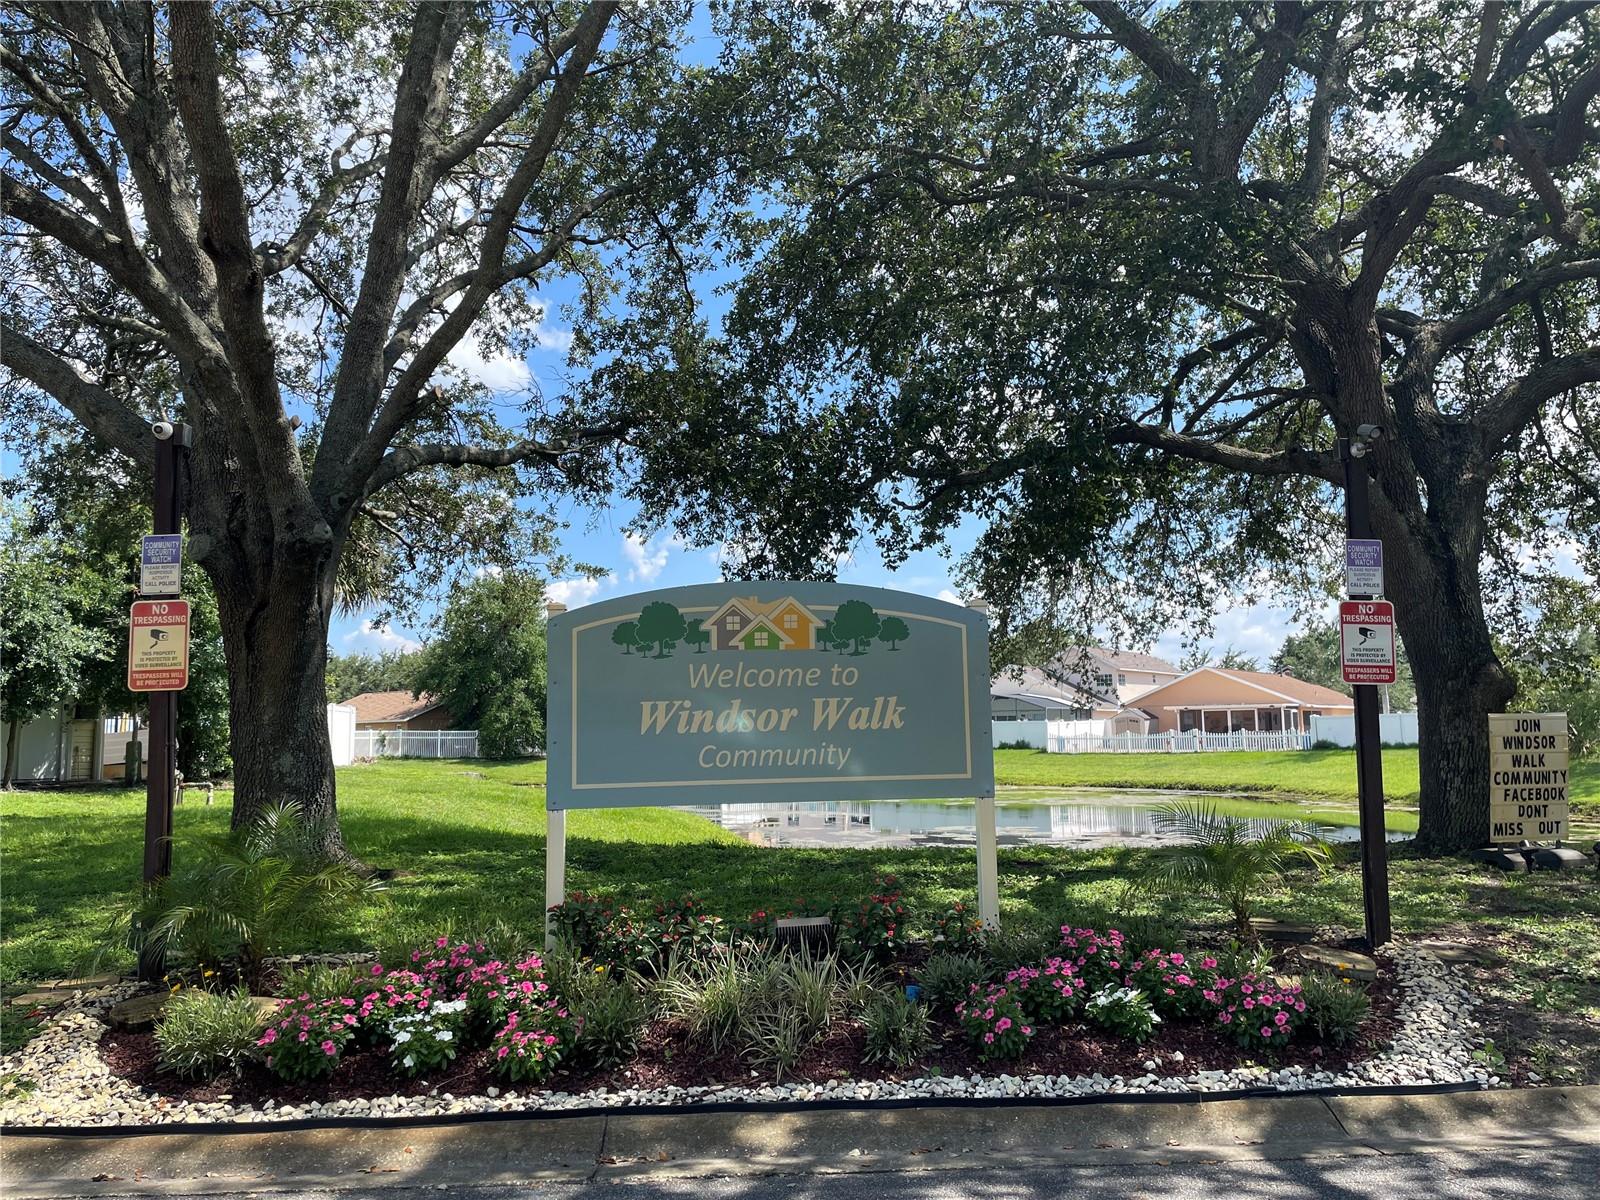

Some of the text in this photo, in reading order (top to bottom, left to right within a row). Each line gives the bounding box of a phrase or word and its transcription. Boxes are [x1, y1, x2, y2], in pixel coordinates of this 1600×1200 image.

[145, 541, 179, 549] COMMUNITY
[152, 604, 168, 614] NO
[1359, 605, 1374, 614] NO
[134, 615, 186, 624] TRESPASSING
[688, 661, 859, 688] Welcome to
[640, 696, 906, 735] Windsor Walk
[1515, 719, 1540, 732] JOIN
[1503, 736, 1555, 749] WINDSOR
[698, 742, 851, 770] Community
[1512, 754, 1546, 768] WALK
[1494, 770, 1567, 785] COMMUNITY
[1504, 788, 1565, 801] FACEBOOK
[1519, 804, 1548, 818] DONT
[1494, 821, 1561, 836] MISS OUT
